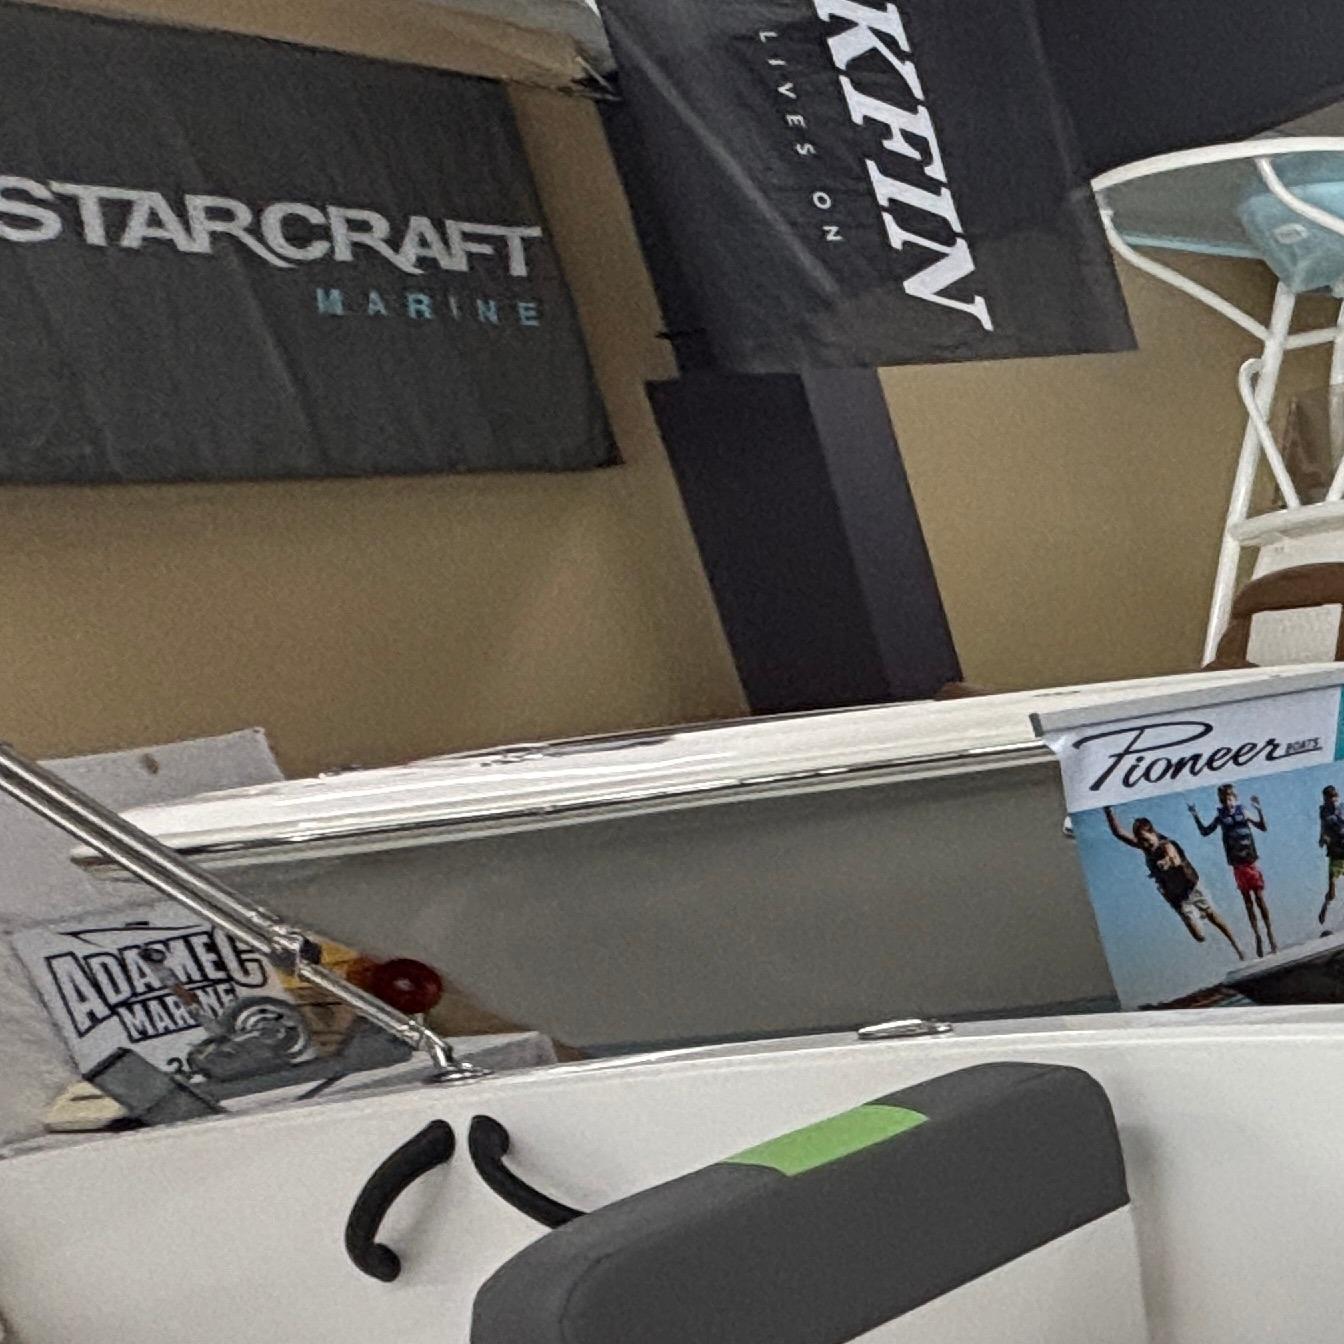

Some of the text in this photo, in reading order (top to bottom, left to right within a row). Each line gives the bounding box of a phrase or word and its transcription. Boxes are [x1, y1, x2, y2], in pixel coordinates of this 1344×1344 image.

[758, 30, 843, 243] LIVES ON
[0, 175, 543, 278] STARCRAFT
[316, 287, 541, 327] MARINE
[1072, 720, 1321, 792] Pioneer BOATS
[115, 983, 237, 1043] MARNE
